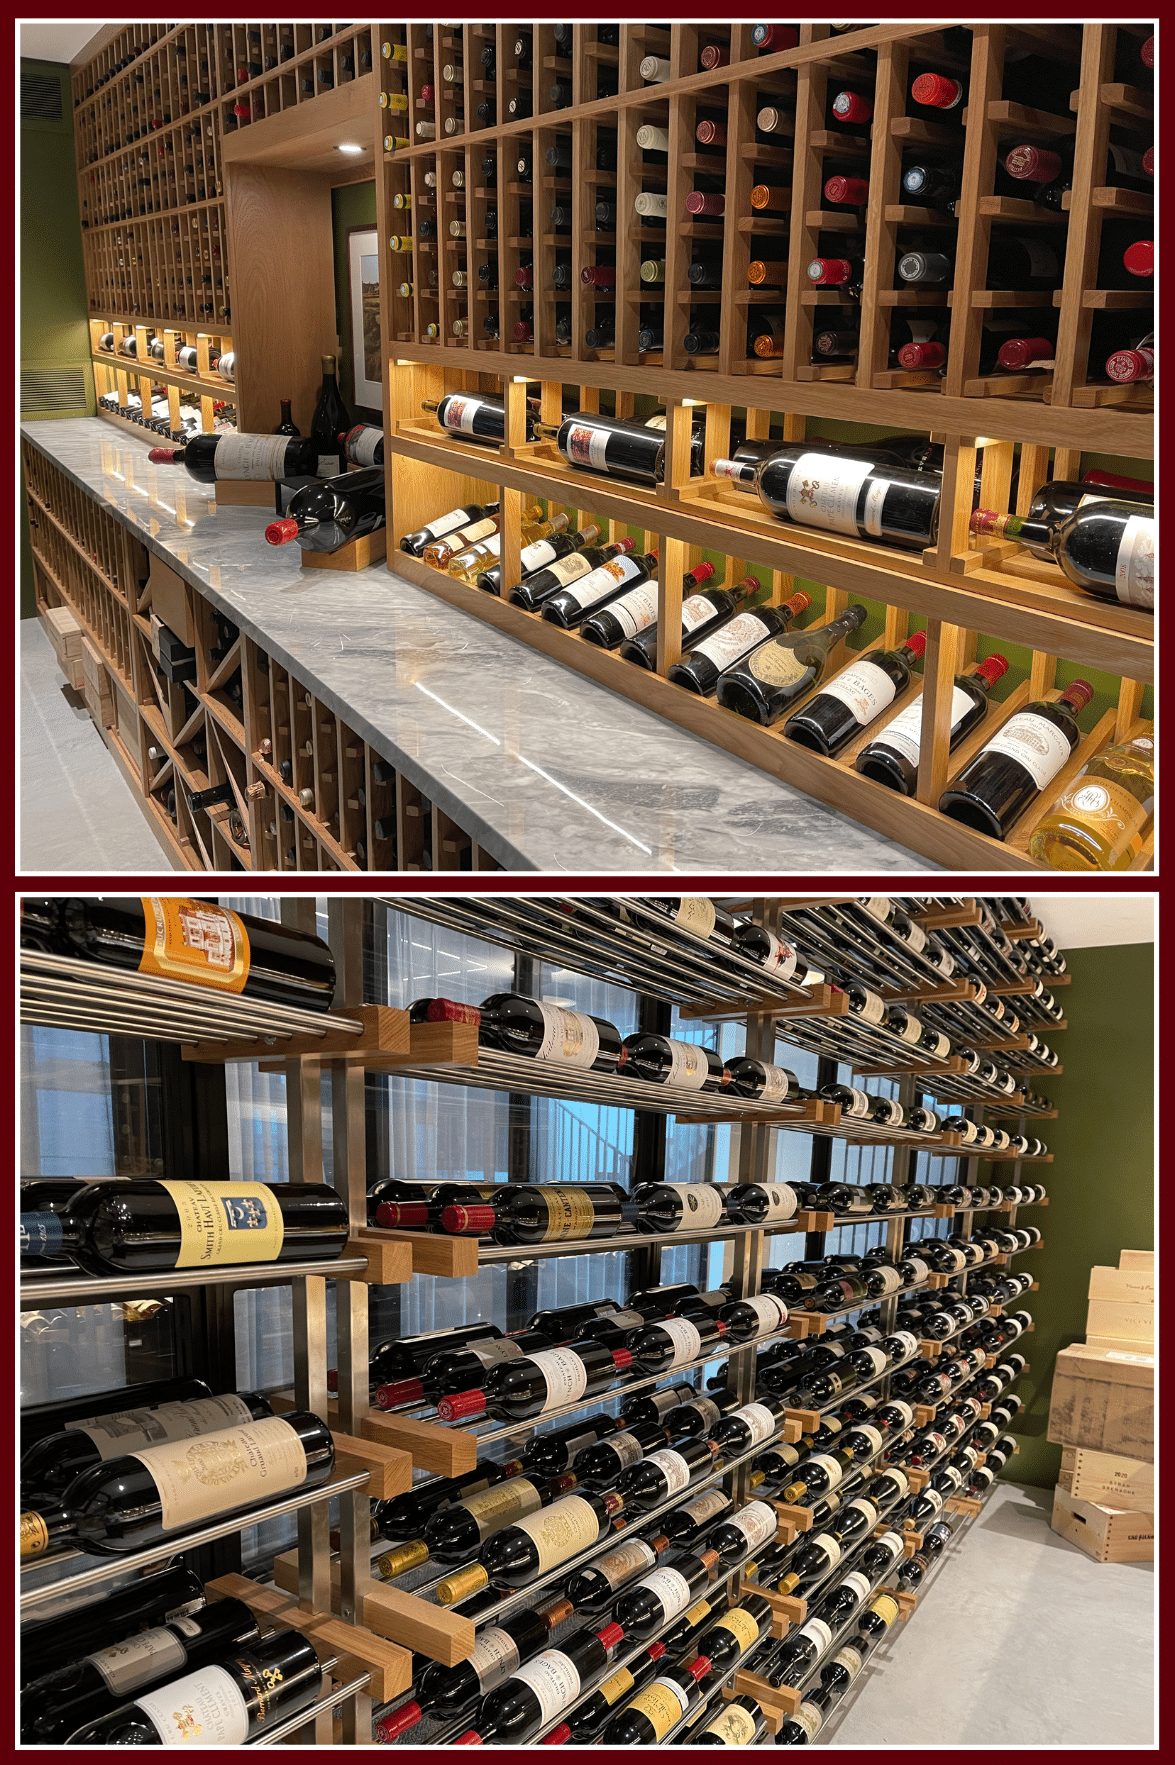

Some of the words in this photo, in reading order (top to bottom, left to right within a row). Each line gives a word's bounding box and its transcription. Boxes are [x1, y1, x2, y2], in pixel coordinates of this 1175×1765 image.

[852, 680, 878, 706] BAGES
[1038, 721, 1064, 757] MARGAUX
[200, 1231, 215, 1260] SMITH
[254, 1445, 267, 1479] Gruaud
[1102, 1485, 1135, 1495] GRENACHE
[251, 1685, 266, 1723] Bernard
